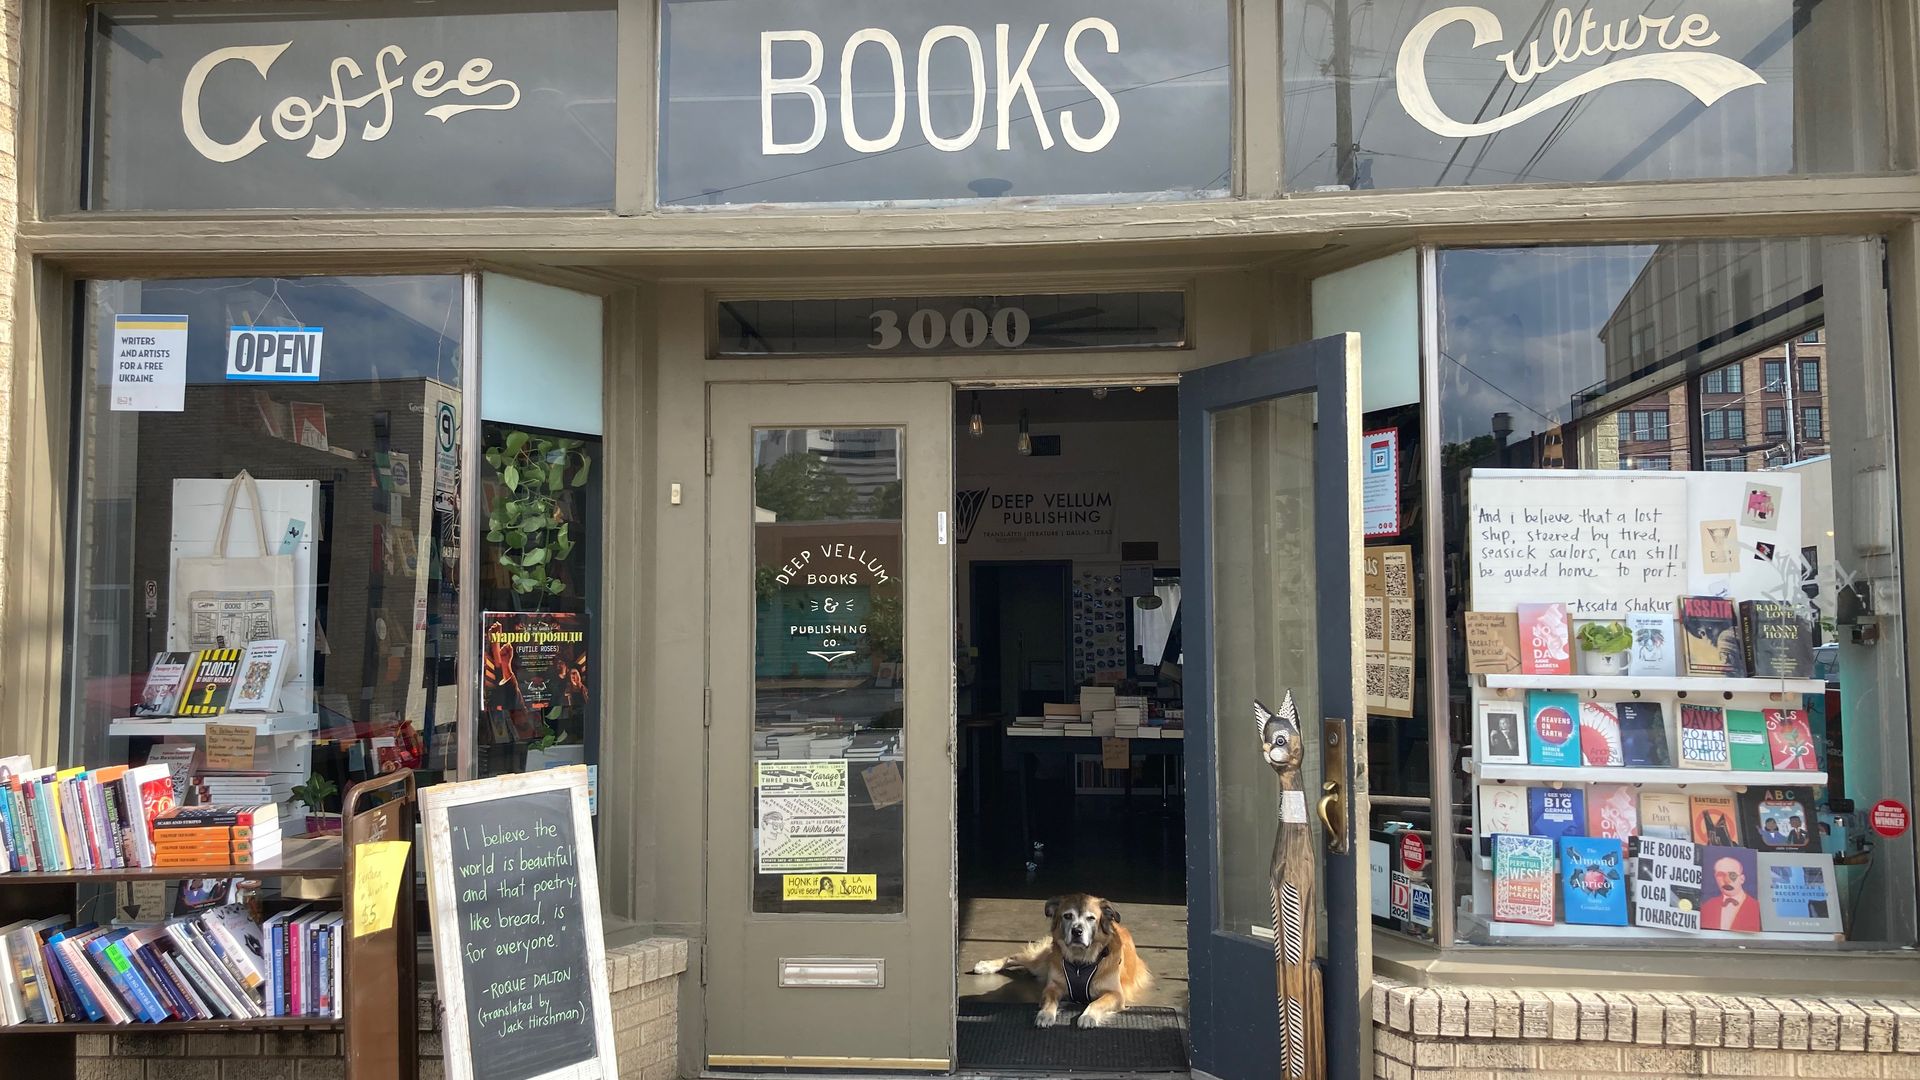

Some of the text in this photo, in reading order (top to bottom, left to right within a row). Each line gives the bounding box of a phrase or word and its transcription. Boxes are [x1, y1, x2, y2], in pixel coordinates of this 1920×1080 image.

[1395, 5, 1767, 138] Culture
[760, 17, 1120, 156] BOOKS
[182, 40, 521, 163] Coffee
[867, 306, 1030, 351] 3000
[121, 336, 156, 346] WRITERS
[120, 349, 170, 358] AND ARTISTS
[234, 332, 316, 374] OPEN
[119, 362, 163, 370] FOR A FREE
[119, 374, 154, 383] UKRAINE
[992, 492, 1112, 509] DEEP VELLUM
[1004, 510, 1100, 525] PUBLISHING
[1510, 511, 1514, 524] i
[1524, 508, 1573, 524] believe
[1578, 508, 1612, 523] that
[1616, 514, 1626, 523] a
[1634, 508, 1662, 523] lost
[1482, 526, 1661, 548] ship, steered by tired,
[1482, 544, 1678, 562] seasick sailors, can still
[776, 543, 889, 585] DEEP VELLUM
[1479, 562, 1495, 578] be
[1504, 562, 1548, 583] guided
[1558, 562, 1598, 578] home
[1616, 563, 1630, 577] to
[807, 573, 858, 585] BOOKS
[824, 597, 839, 613] &
[1624, 598, 1672, 612] Shakur
[1685, 599, 1733, 618] ASSATA
[491, 631, 583, 645] марно троянди
[790, 624, 867, 635] PUBLISHING
[200, 662, 236, 676] TLOOTH
[1682, 710, 1723, 730] DAVIS
[1766, 710, 1796, 731] GIRLS
[1683, 729, 1724, 741] WOMEN
[812, 772, 839, 781] Garage
[1544, 798, 1572, 808] BIG
[481, 824, 530, 847] believe
[534, 818, 558, 837] the
[1639, 840, 1692, 861] THE BOOKS
[459, 845, 573, 878] world is beautiful
[1509, 860, 1540, 868] PERPETUAL
[1570, 856, 1615, 867] Almond
[1393, 874, 1409, 884] BEST
[1510, 867, 1540, 879] WEST
[1655, 864, 1702, 885] OF JACOB
[462, 879, 488, 903] and
[497, 877, 526, 898] that
[788, 878, 819, 888] HONK if
[1572, 880, 1614, 890] Apricot
[1394, 883, 1407, 908] D
[1413, 891, 1429, 905] ABA
[1641, 884, 1667, 902] OLGA
[470, 901, 564, 932] like bread, is
[1392, 906, 1408, 918] 2021
[1639, 906, 1698, 930] TOKARCZUK
[465, 944, 487, 964] for
[533, 967, 571, 989] DALTON
[131, 979, 139, 988] NO
[136, 988, 151, 1005] MAYBE
[478, 993, 550, 1028] (translated by
[498, 1000, 586, 1038] Jack Hirshman)
